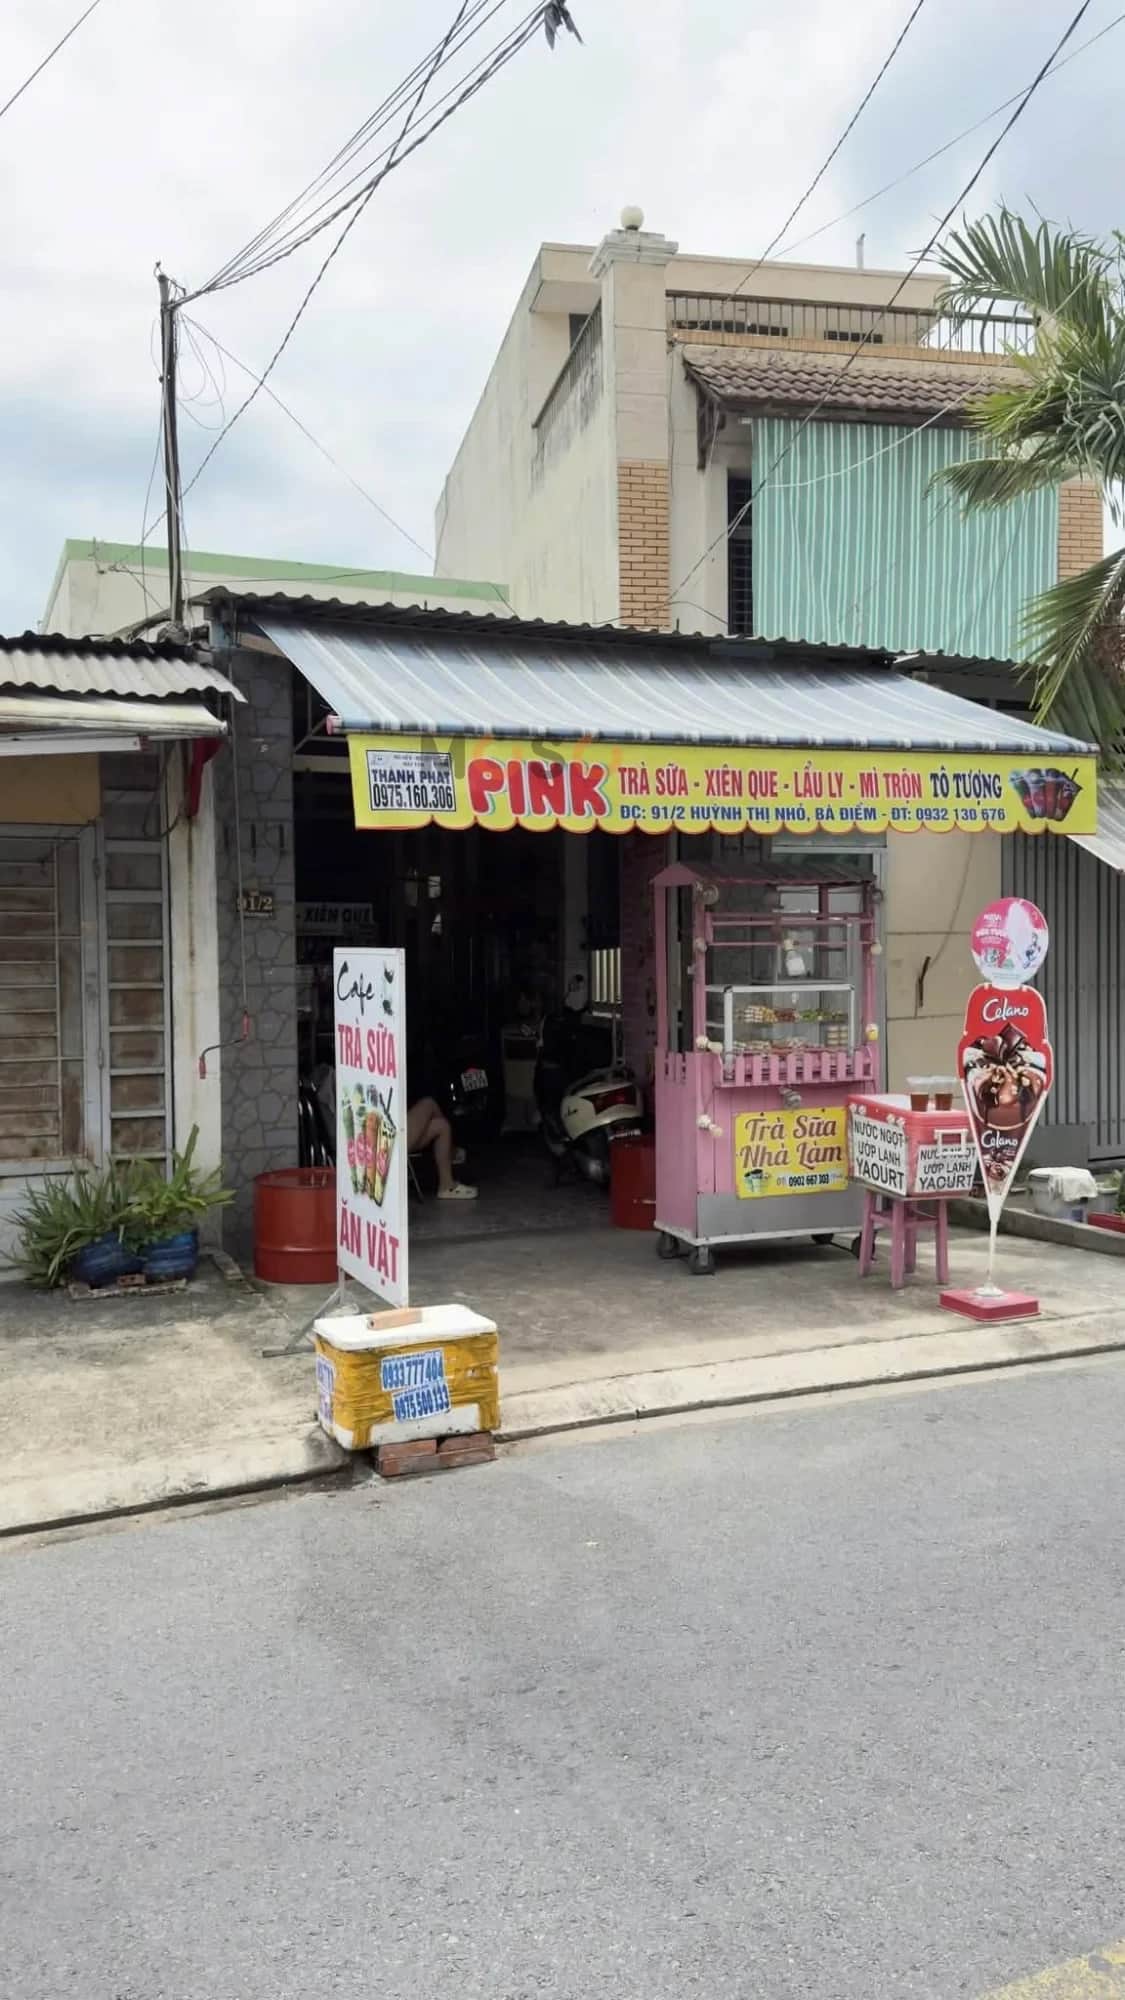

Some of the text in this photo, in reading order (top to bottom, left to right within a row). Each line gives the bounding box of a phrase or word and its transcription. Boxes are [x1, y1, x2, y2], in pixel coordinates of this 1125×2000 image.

[373, 783, 453, 809] 0975.160.306
[466, 757, 609, 818] PINK
[618, 761, 650, 796] TRÀ
[655, 762, 689, 796] SỮA
[704, 763, 743, 798] XIÊN
[748, 770, 778, 800] QUE
[794, 760, 823, 798] LẨU
[828, 771, 843, 798] LY
[859, 766, 880, 798] MÌ
[930, 765, 949, 799] TÔ
[953, 768, 1002, 806] TƯỢNG
[620, 804, 646, 820] ĐC:
[652, 805, 686, 820] 91/2
[691, 802, 742, 820] HUỲNH
[748, 807, 770, 824] THỊ
[815, 804, 835, 821] BÀ
[891, 807, 912, 821] ĐT:
[916, 807, 949, 821] 0932
[954, 808, 977, 821] 130
[337, 1016, 397, 1079] TRÀ SỮA
[745, 1115, 837, 1141] Trà Sữa
[740, 1140, 842, 1170] Nhà Làm
[856, 1159, 905, 1190] YAOURT
[919, 1174, 973, 1190] YAOURT
[340, 1197, 400, 1286] ĂN VẶT
